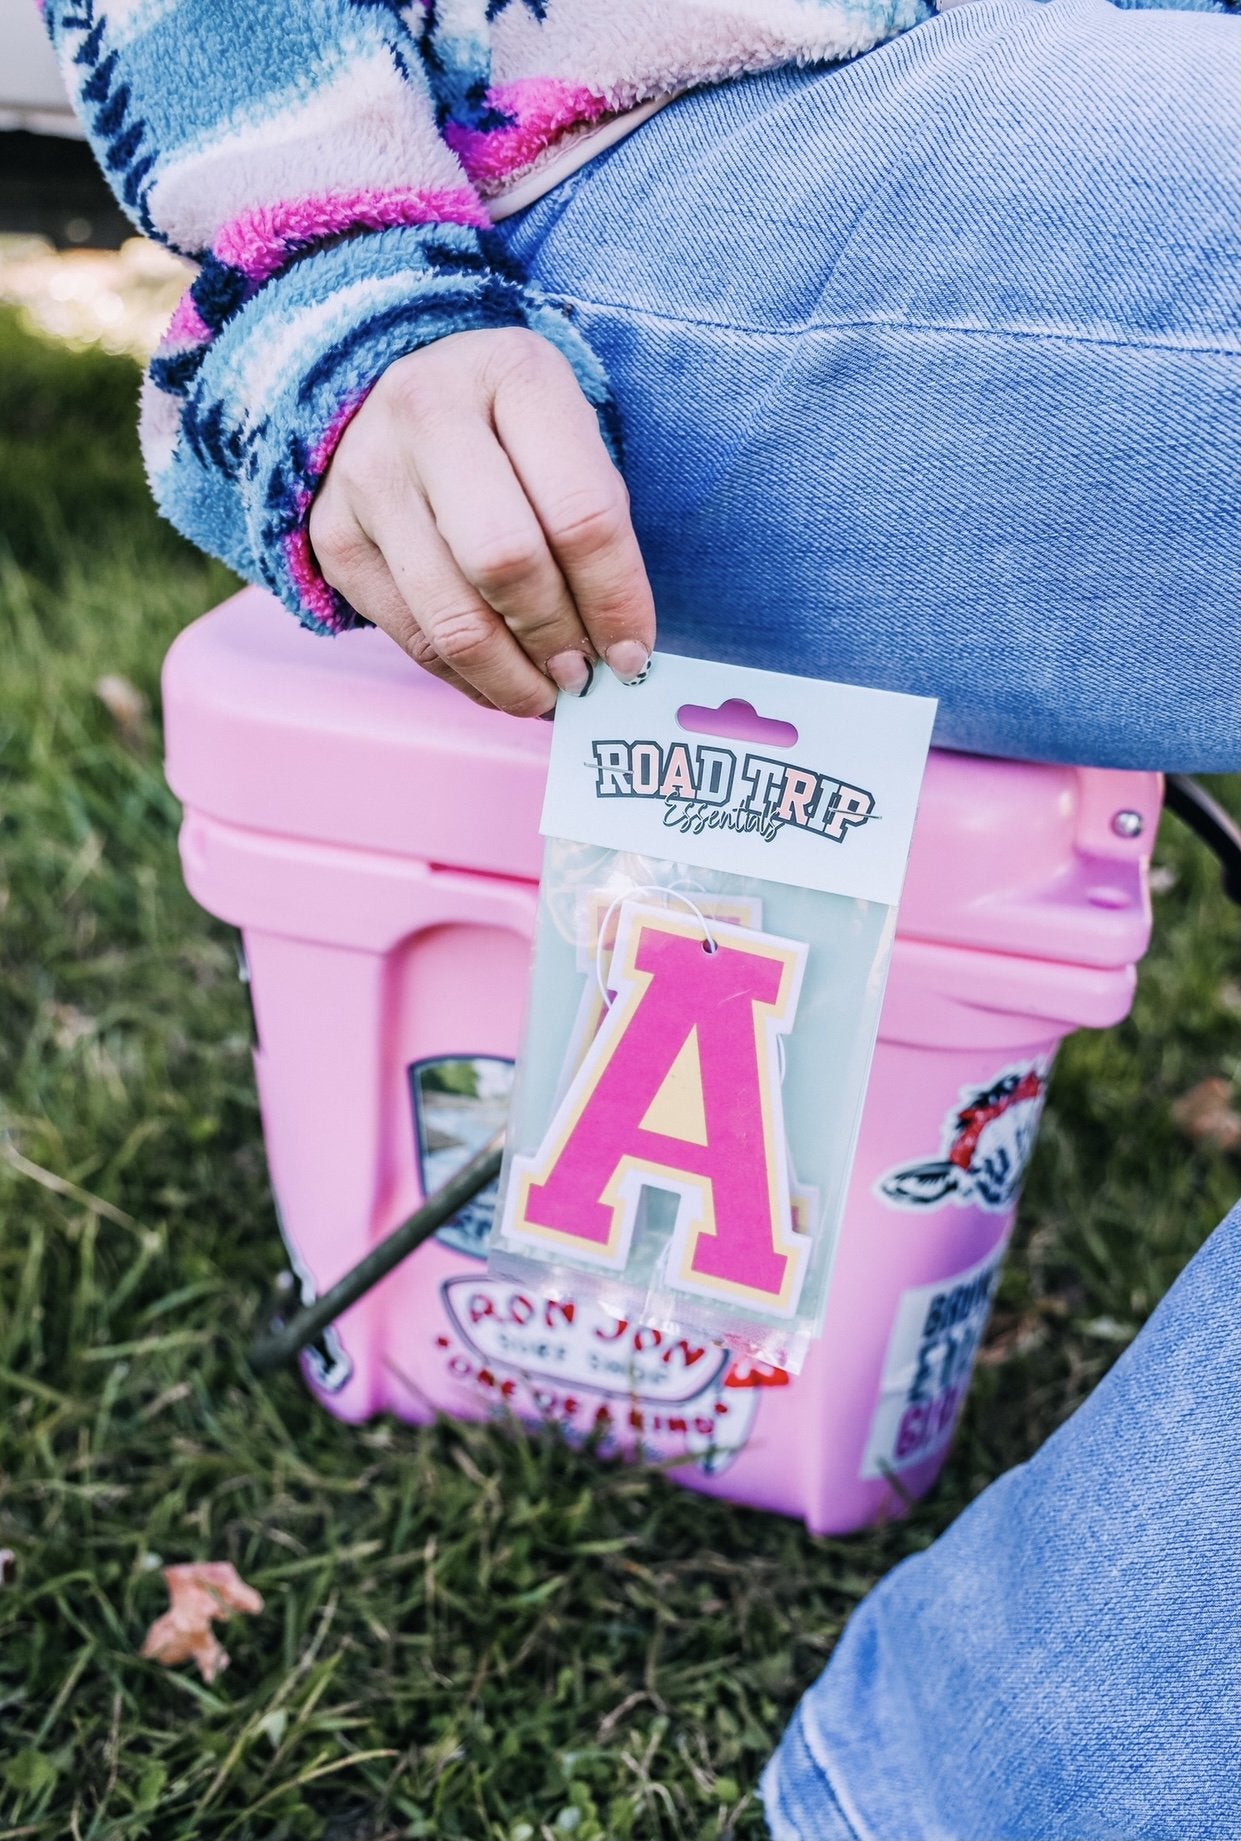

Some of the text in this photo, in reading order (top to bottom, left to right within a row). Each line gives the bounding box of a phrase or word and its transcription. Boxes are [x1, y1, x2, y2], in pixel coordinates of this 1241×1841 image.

[591, 740, 876, 844] ROAD TRIP
[661, 790, 786, 843] Essentials
[518, 920, 792, 1300] A
[468, 1293, 576, 1328] RON
